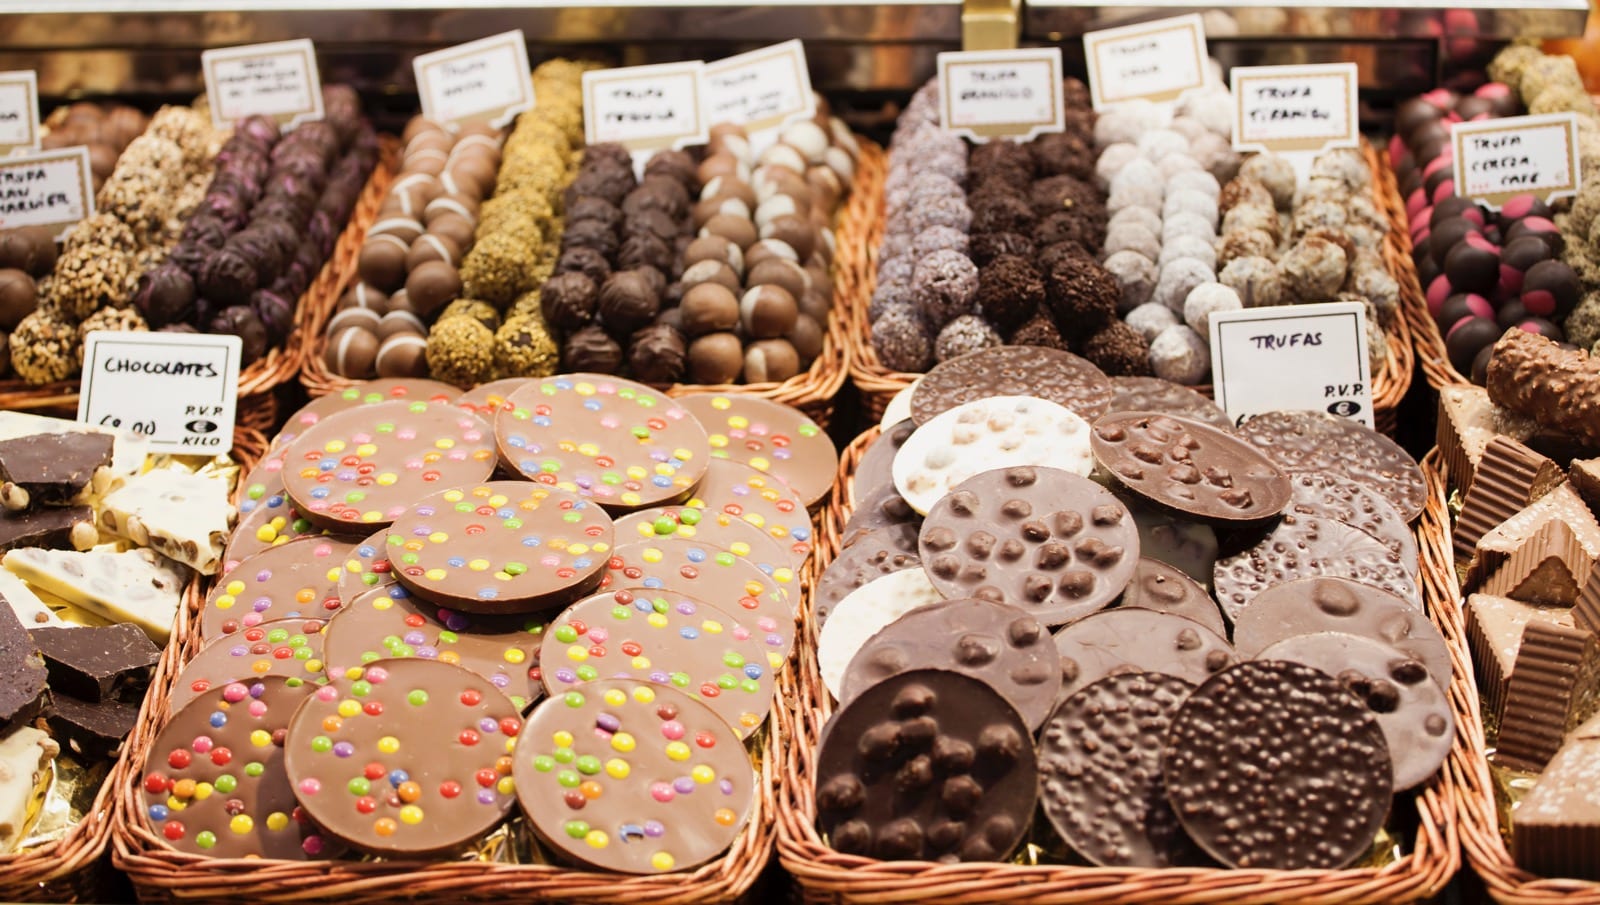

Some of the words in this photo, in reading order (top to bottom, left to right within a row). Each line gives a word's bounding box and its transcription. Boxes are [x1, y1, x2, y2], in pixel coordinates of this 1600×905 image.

[1256, 86, 1311, 99] TRUFA
[1472, 135, 1521, 149] TRUFA
[1249, 332, 1323, 350] TRUFAS
[104, 357, 218, 378] CHOCOLATES
[1323, 383, 1363, 397] P.V.P.
[184, 405, 223, 416] P.V.P.
[181, 436, 221, 446] KILO
